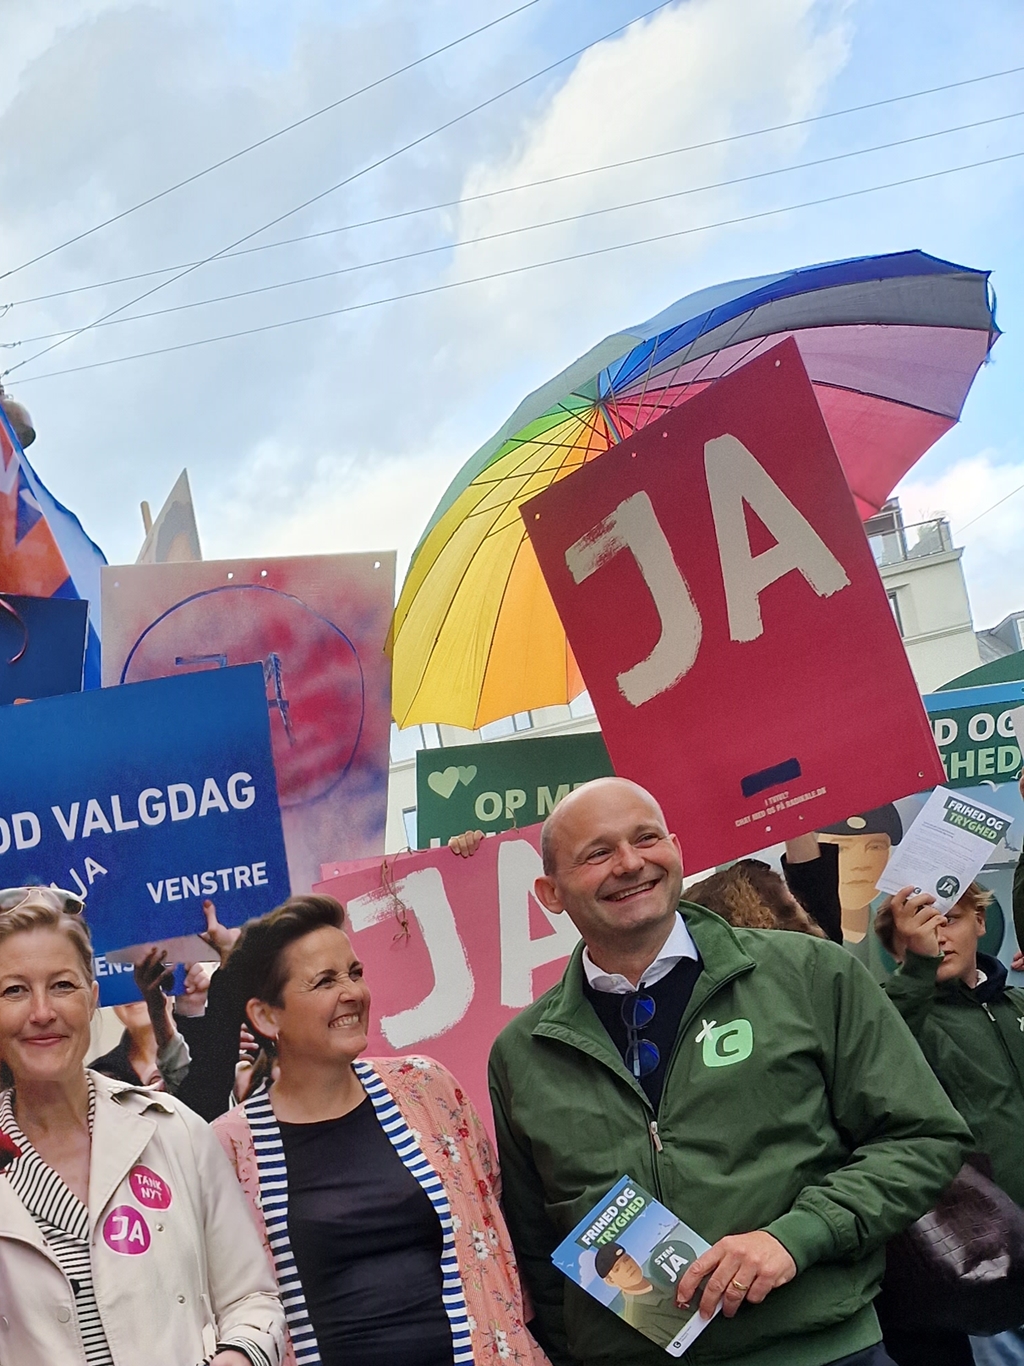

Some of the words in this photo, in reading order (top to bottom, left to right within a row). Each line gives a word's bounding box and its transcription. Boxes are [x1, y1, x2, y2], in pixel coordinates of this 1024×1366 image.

[564, 433, 851, 708] JA
[968, 709, 1016, 742] OG
[51, 771, 257, 841] VALGDAG
[474, 788, 526, 822] OP
[948, 799, 986, 822] FRIHED
[986, 817, 1004, 831] OG
[948, 812, 997, 840] TRYGHED
[146, 861, 269, 904] VENSTRE
[937, 881, 954, 895] JA
[346, 839, 583, 1049] JA
[140, 1186, 162, 1201] NYT
[109, 1215, 145, 1247] JA
[581, 1205, 619, 1247] FRIHED
[616, 1187, 636, 1211] OG
[596, 1195, 646, 1245] TRYGHED
[654, 1245, 675, 1265] STEM
[659, 1253, 689, 1283] JA
